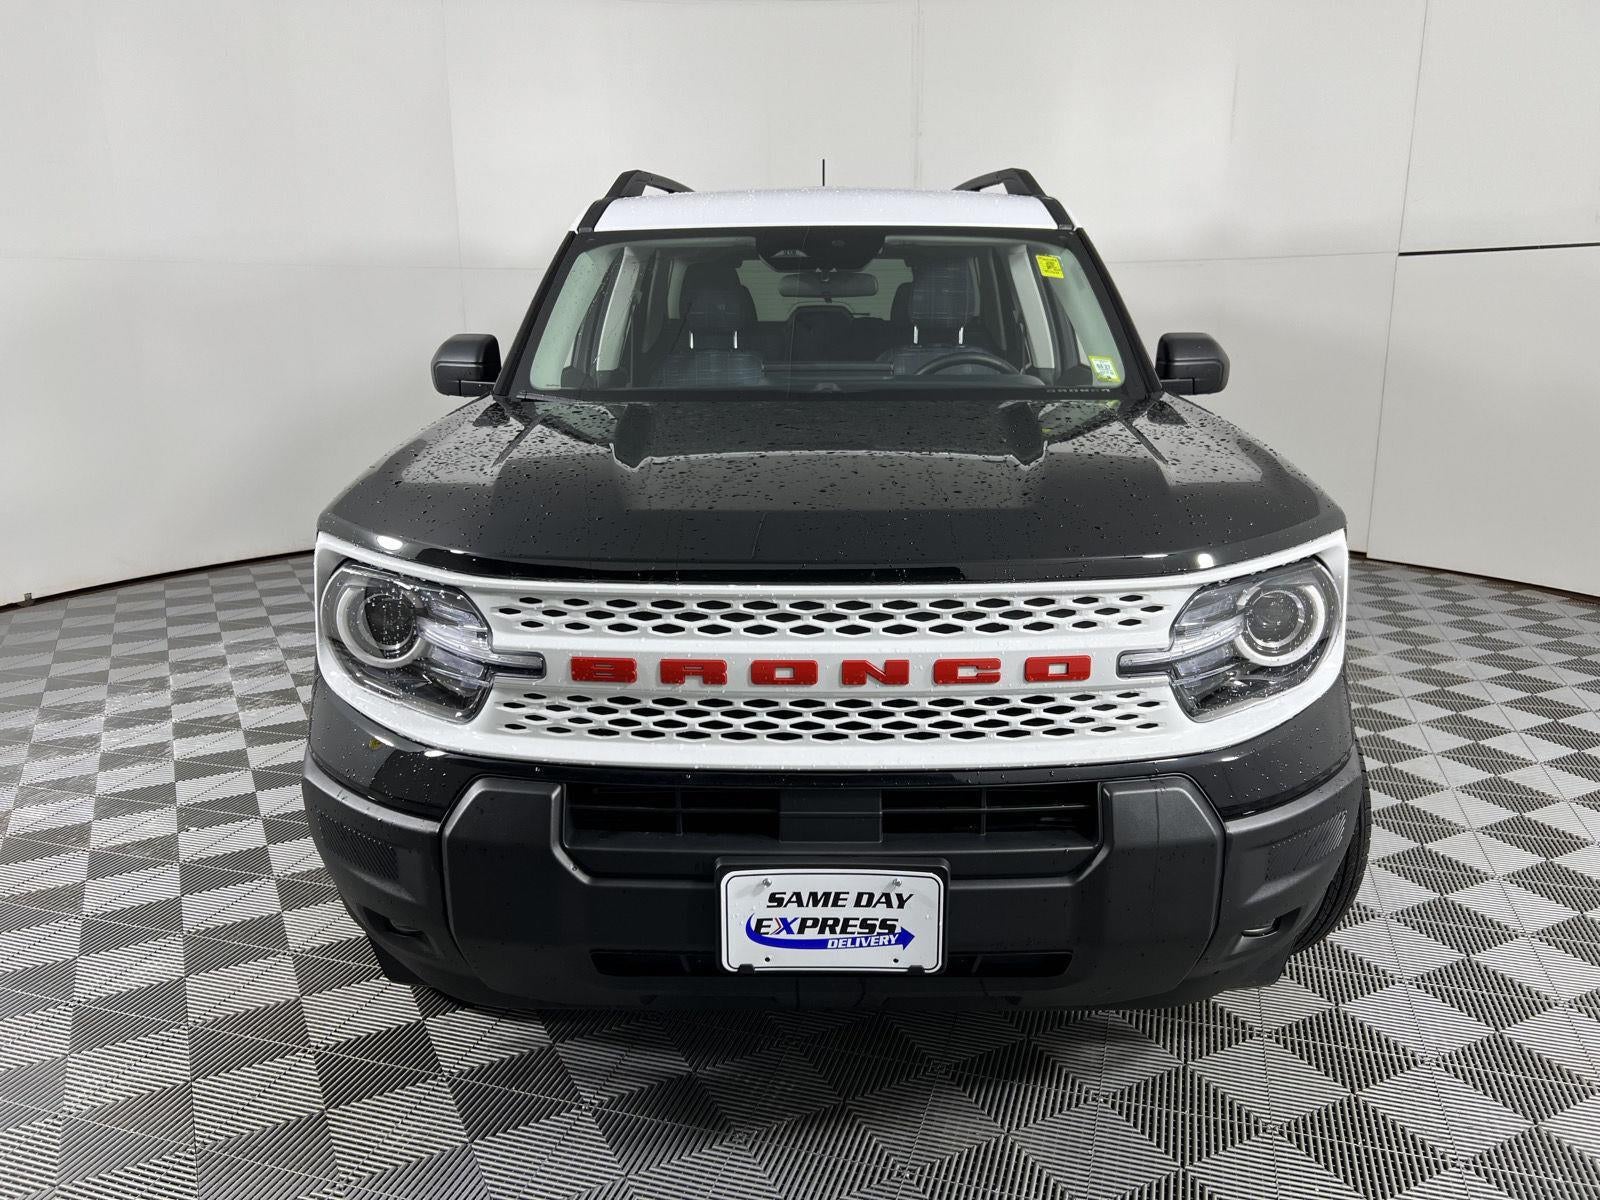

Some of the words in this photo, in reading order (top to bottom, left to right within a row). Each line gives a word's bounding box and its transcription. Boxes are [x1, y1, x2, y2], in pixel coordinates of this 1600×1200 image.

[571, 655, 1092, 686] BRONCO
[767, 891, 849, 908] SAME
[853, 892, 916, 909] DAY
[753, 917, 899, 936] EXPRESS
[827, 933, 900, 949] DELIVERY
